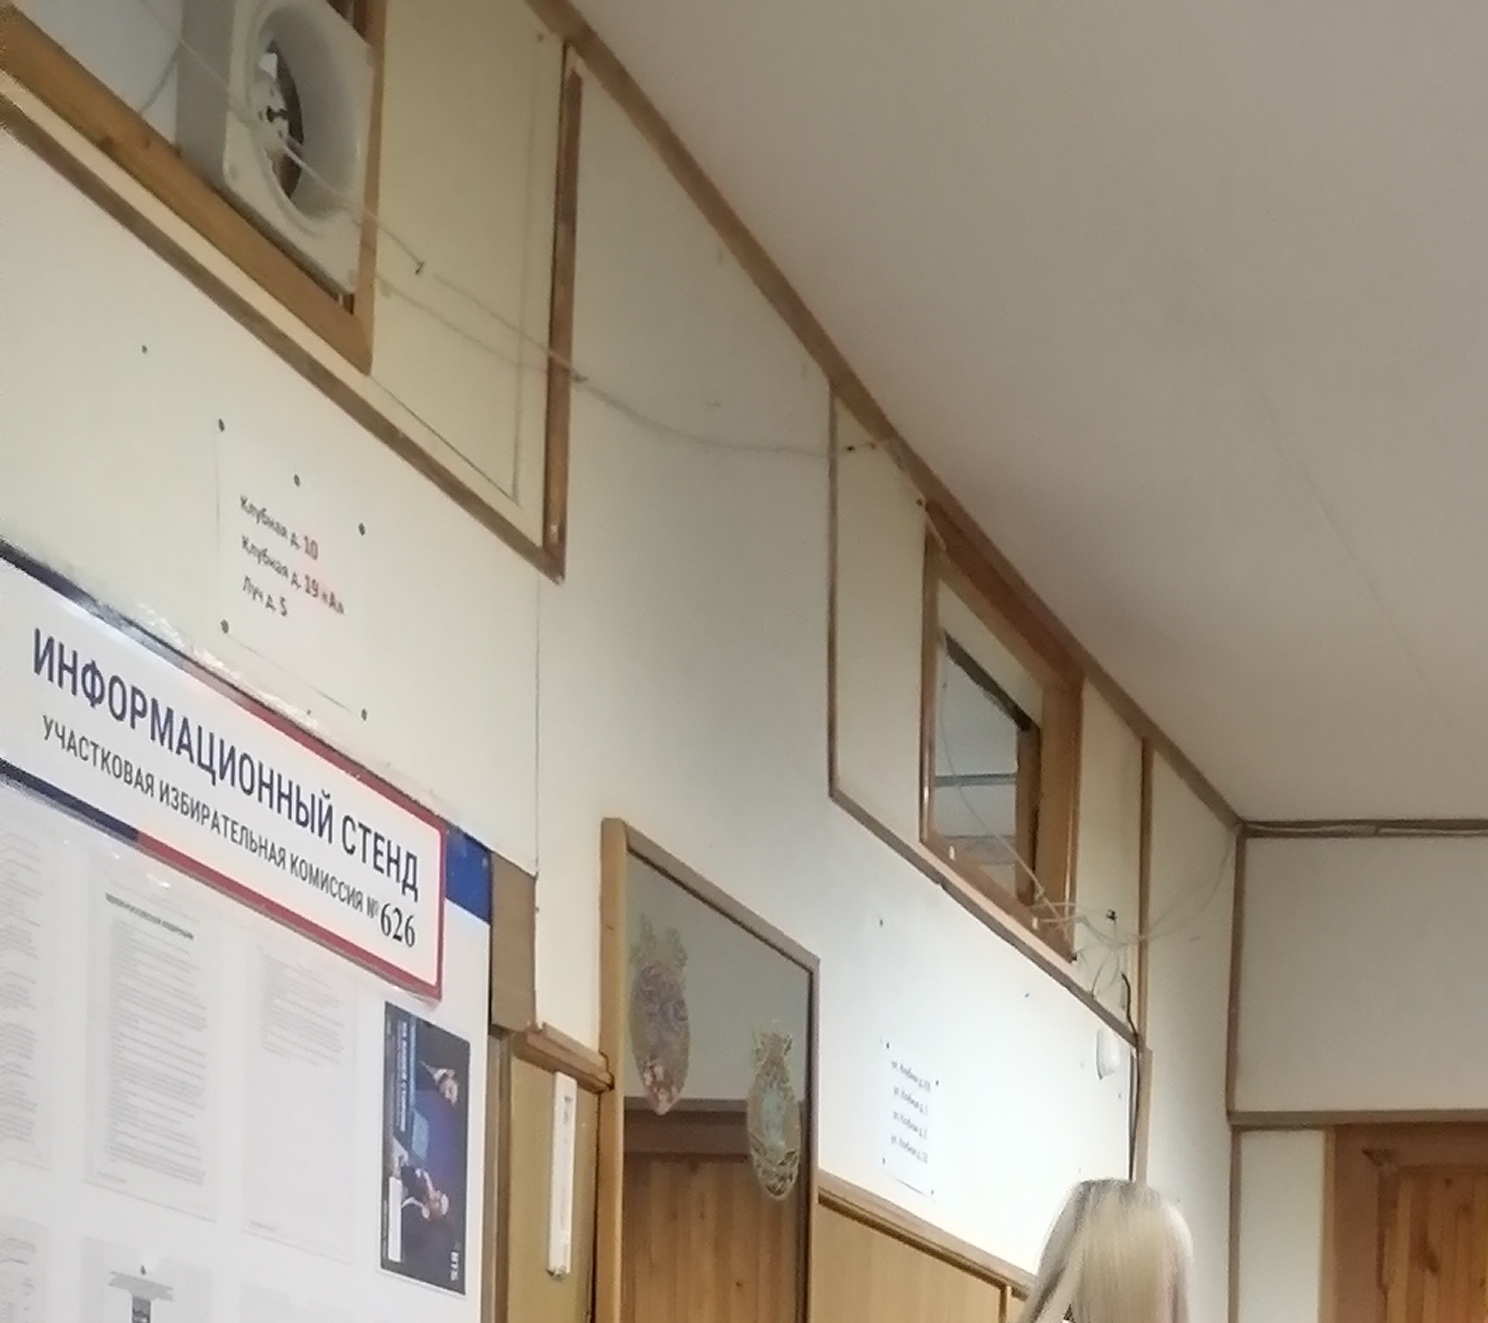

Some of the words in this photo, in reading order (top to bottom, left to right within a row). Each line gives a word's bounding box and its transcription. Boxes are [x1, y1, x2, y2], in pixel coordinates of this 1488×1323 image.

[304, 535, 319, 561] 10
[33, 627, 334, 845] ИНФОРМАЦИОННЫЙ
[341, 815, 419, 902] СТЕНД
[42, 714, 155, 797] УЧАСТКОВАЯ
[159, 780, 287, 870] ИЗБИРАТЕЛЬНАЯ
[290, 853, 363, 913] КОМИССИЯ
[379, 902, 416, 948] 626
